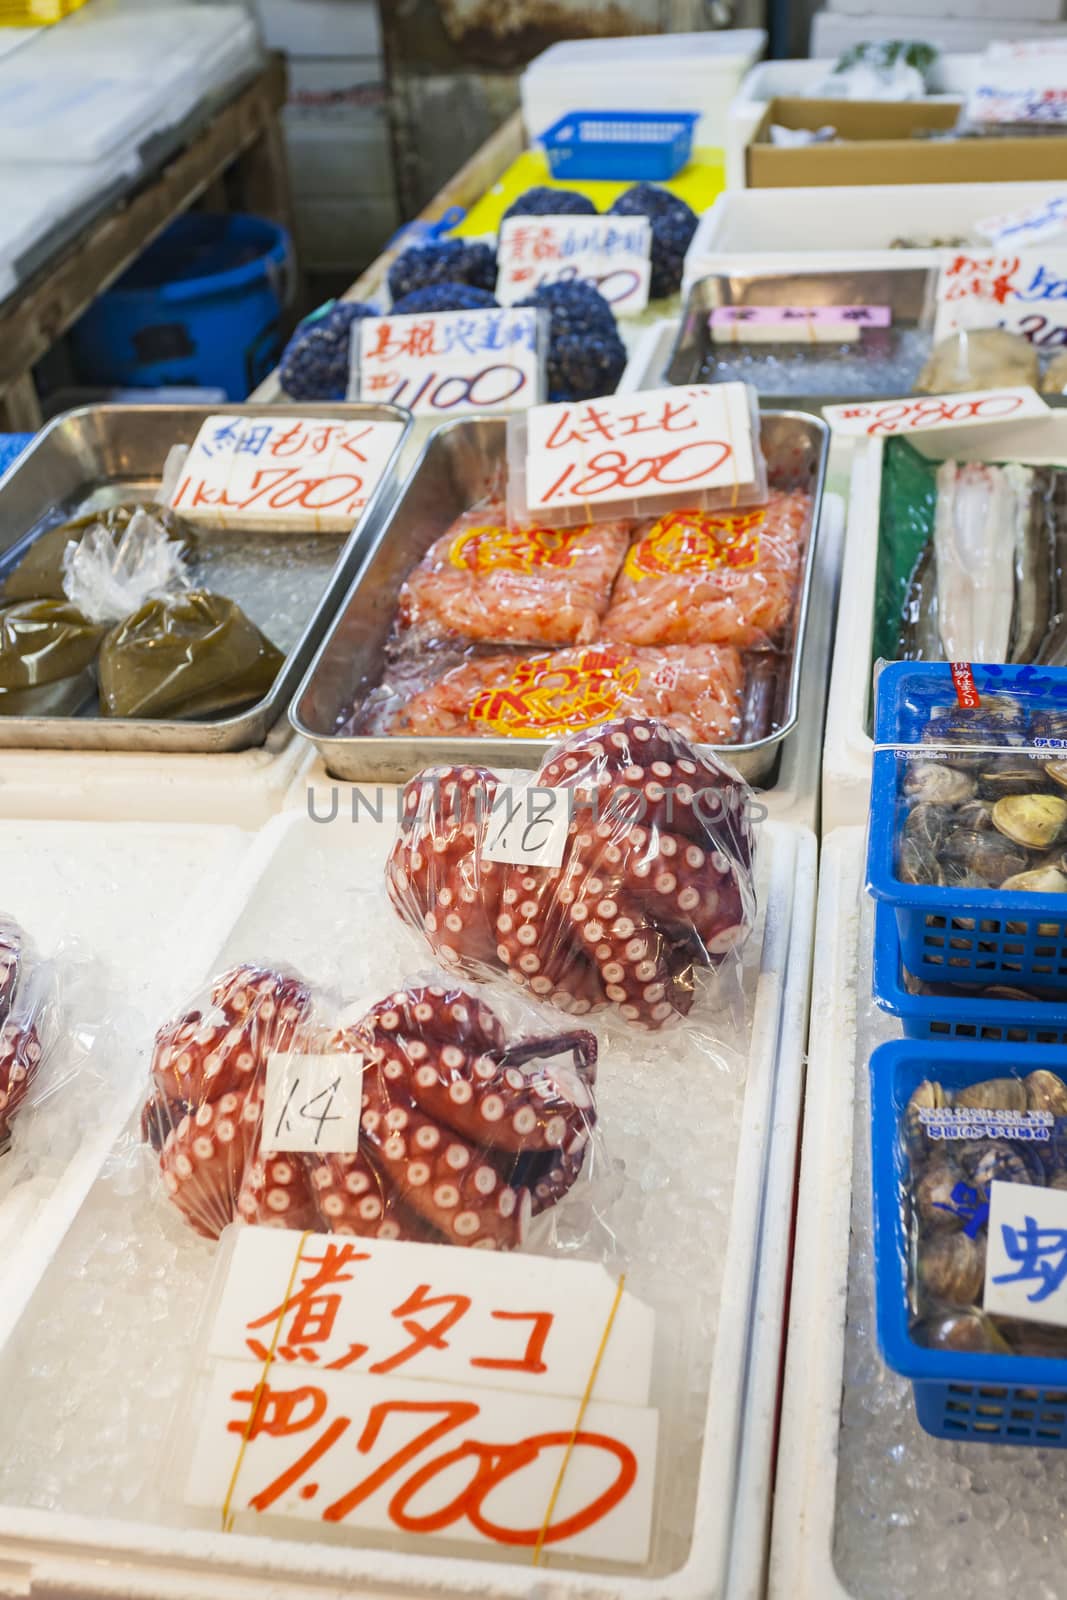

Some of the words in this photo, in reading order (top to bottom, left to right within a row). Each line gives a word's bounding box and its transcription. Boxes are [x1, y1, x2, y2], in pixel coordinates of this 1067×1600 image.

[545, 391, 710, 449] ムキエビ
[275, 1077, 344, 1145] 1.4
[246, 1243, 554, 1374] 煮タコ
